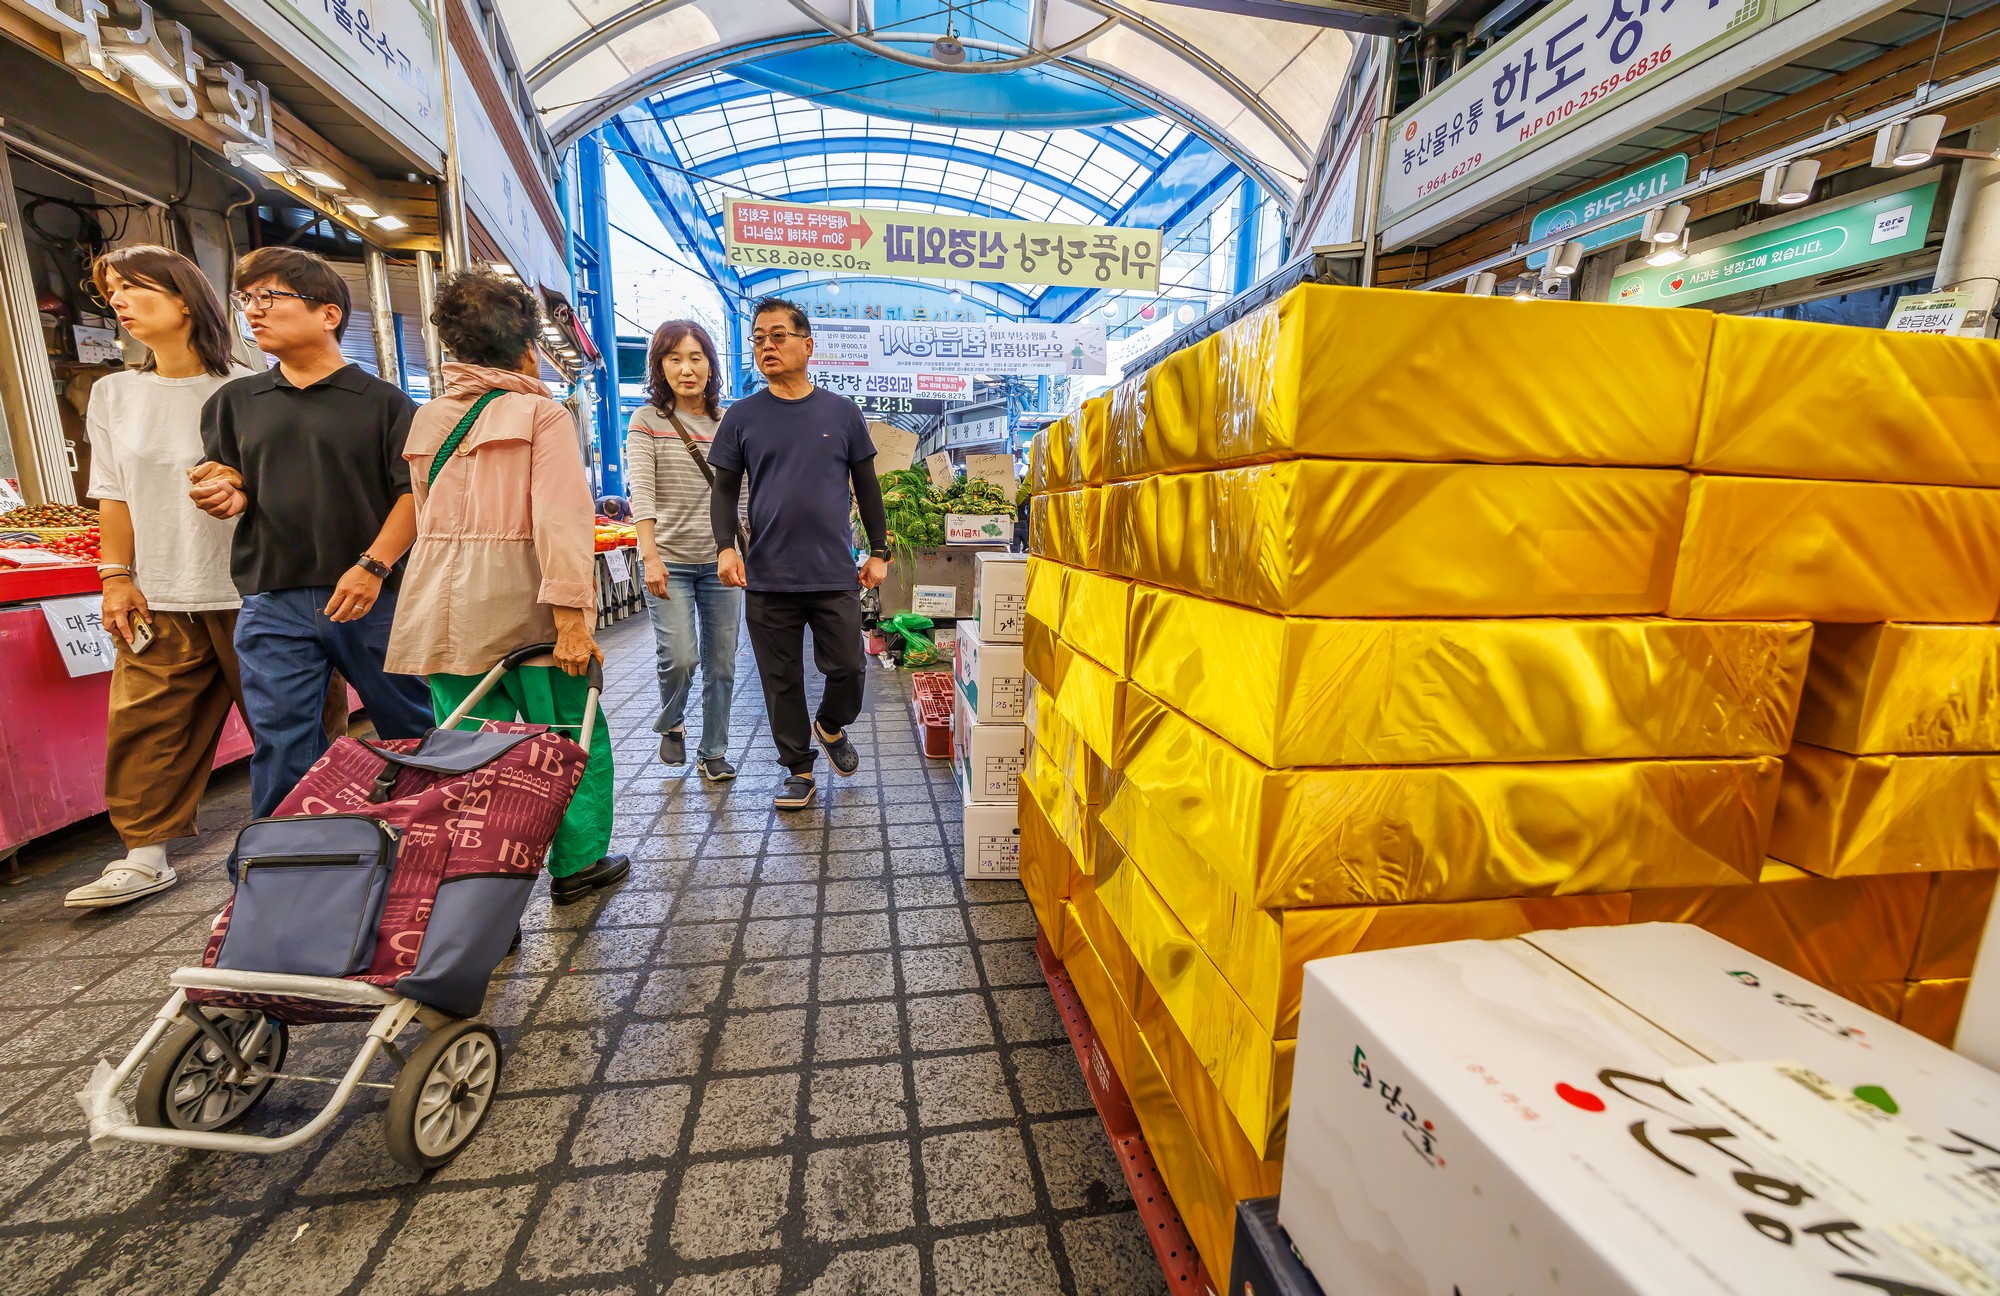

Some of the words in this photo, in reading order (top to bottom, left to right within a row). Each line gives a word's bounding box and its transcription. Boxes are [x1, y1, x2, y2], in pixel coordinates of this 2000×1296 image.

[1402, 97, 1484, 175] 농산물유통
[1493, 0, 1720, 133] 한도상
[1519, 117, 1544, 142] H.P
[1546, 43, 1672, 127] 010-2559-6836
[1417, 152, 1482, 198] T.964-6279
[1689, 267, 1720, 286] 사과는
[1724, 254, 1768, 277] 냉장고에
[1771, 240, 1824, 265] 있습니다.
[1897, 313, 1954, 329] 환급행사
[865, 375, 913, 394] 신경외과
[921, 391, 967, 400] 02.966.8275
[952, 420, 995, 440] 대왕상회
[65, 612, 102, 633] 대추
[1000, 617, 1014, 632] 24
[65, 639, 103, 657] 1kg
